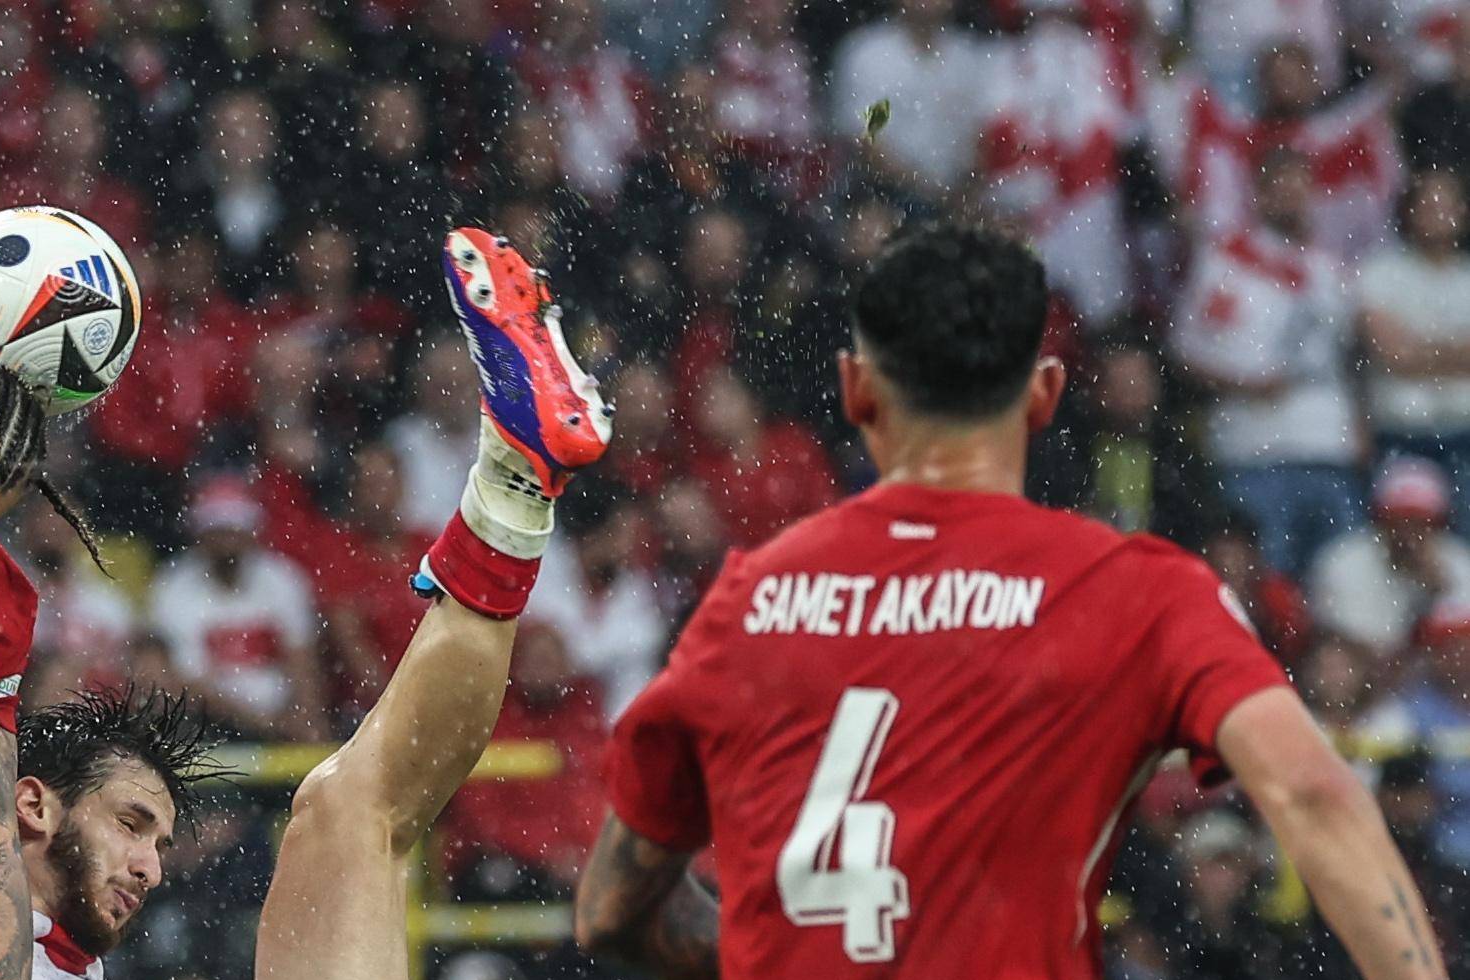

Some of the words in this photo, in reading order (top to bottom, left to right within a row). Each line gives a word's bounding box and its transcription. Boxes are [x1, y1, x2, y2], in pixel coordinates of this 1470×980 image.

[743, 572, 875, 637] SAMET
[869, 568, 1045, 636] AKAYDIN
[777, 687, 910, 963] 4
